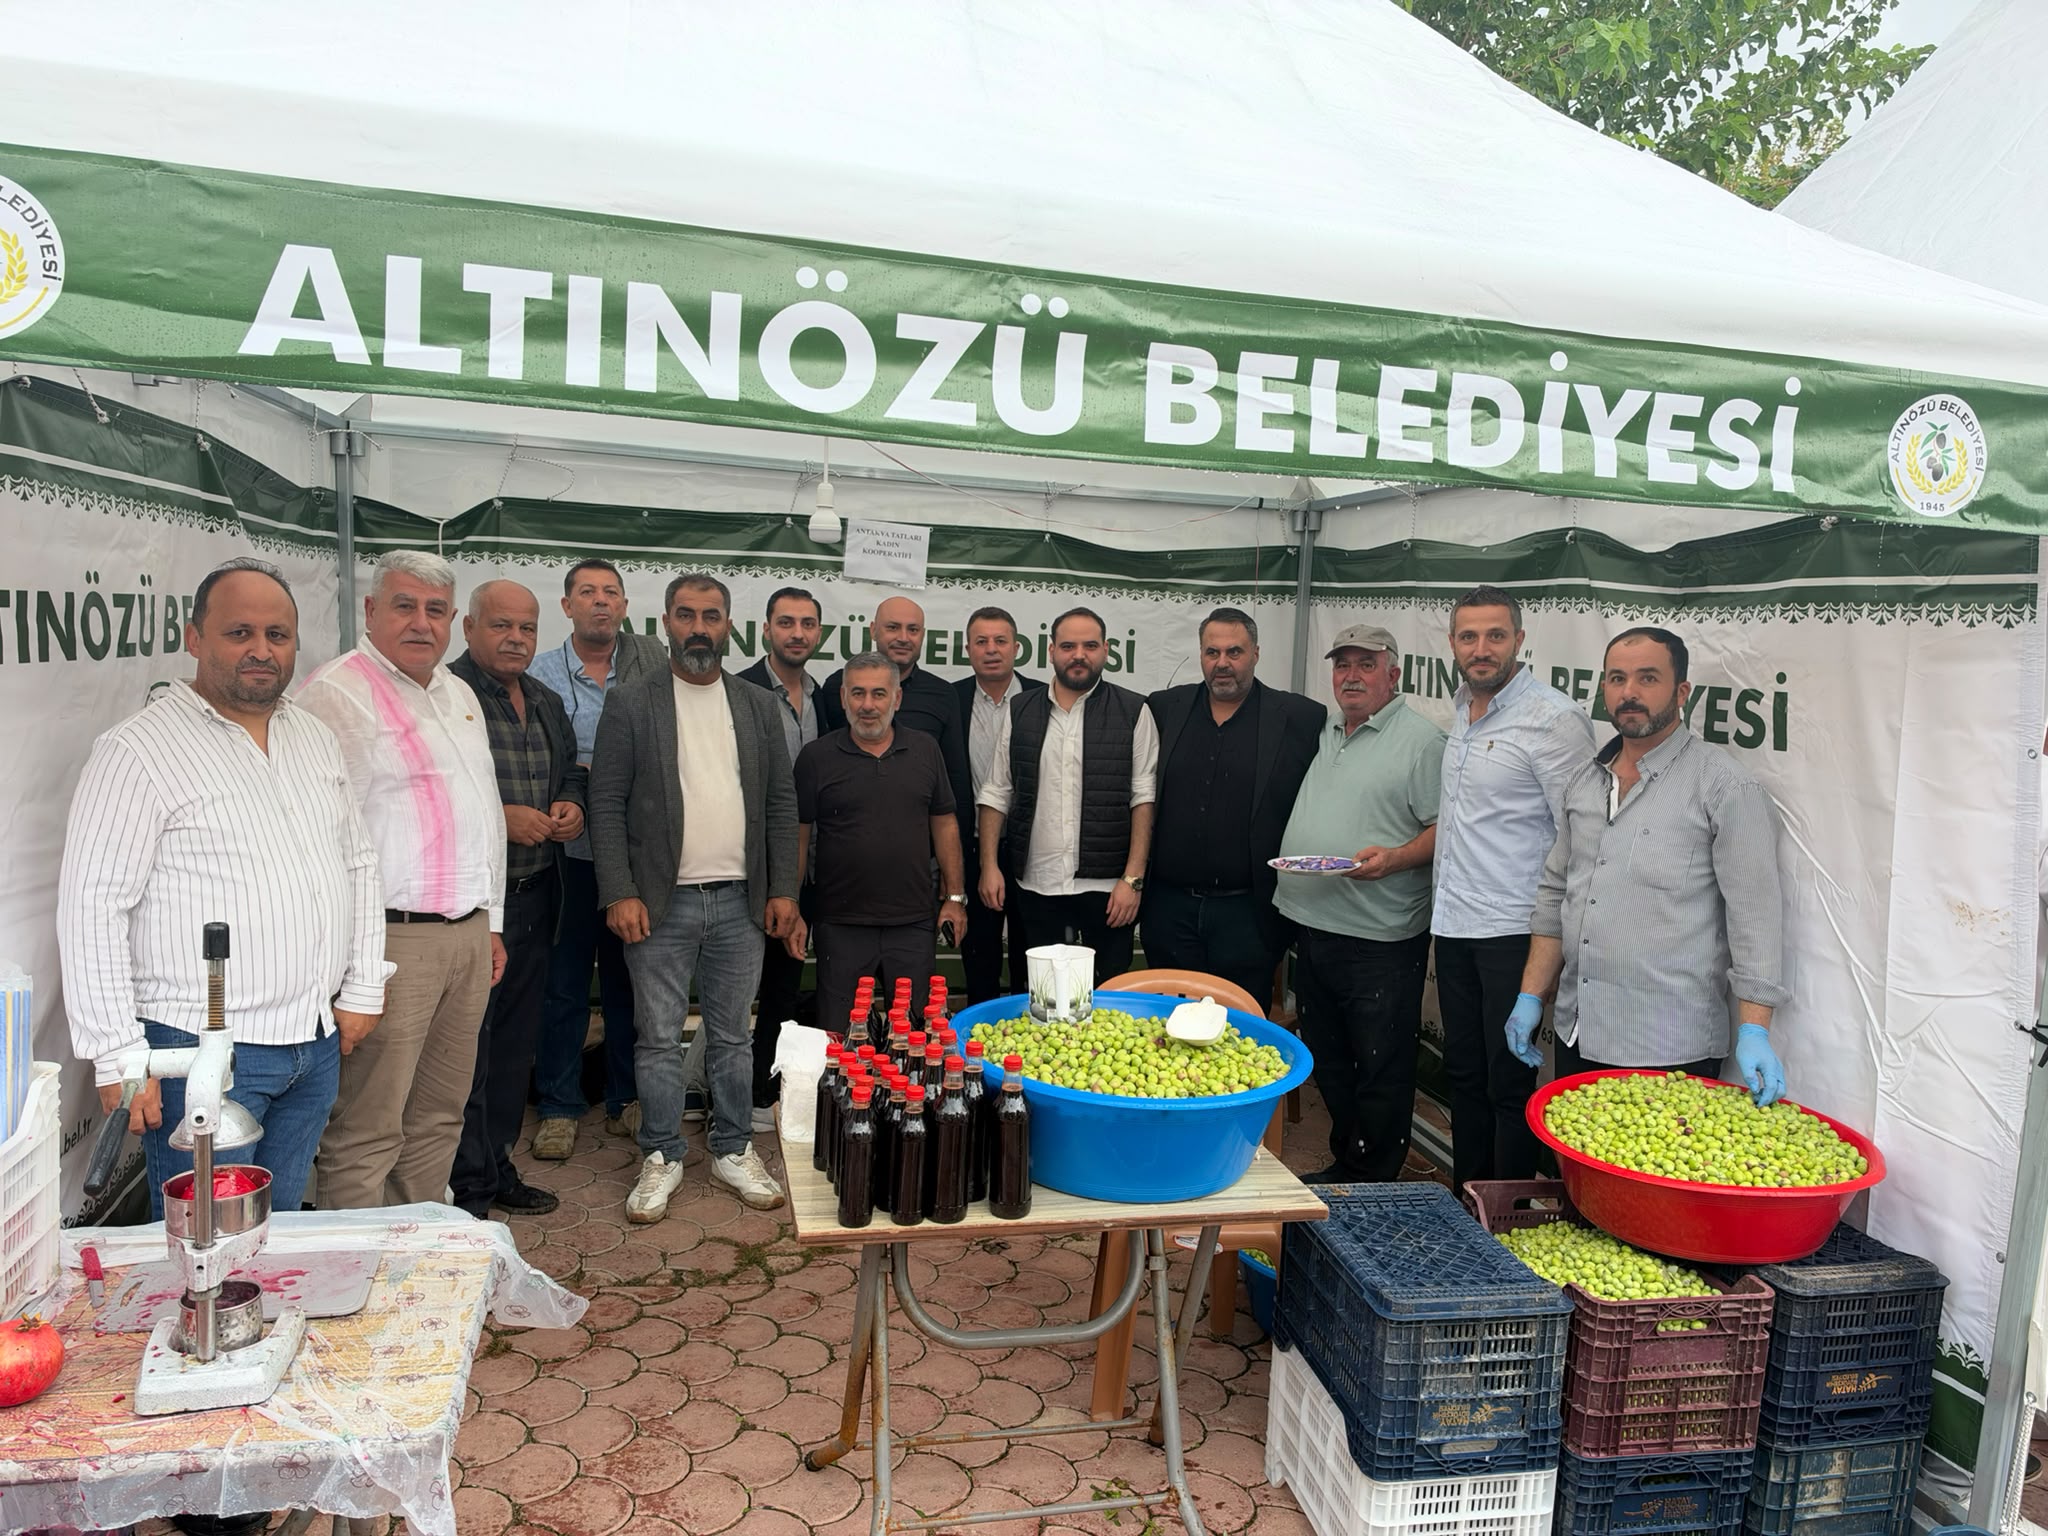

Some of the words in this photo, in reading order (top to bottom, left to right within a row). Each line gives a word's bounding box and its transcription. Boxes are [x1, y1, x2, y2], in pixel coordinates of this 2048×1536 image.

[238, 243, 1087, 437] ALTINÖZÜ
[1144, 341, 1802, 493] BELEDİYESİ
[1891, 399, 1936, 463] ALTINÖZÜ
[1939, 400, 1985, 472] BELEDİYESİ
[1920, 501, 1945, 512] 1945
[856, 528, 890, 538] ANTAKYA
[891, 532, 922, 542] TATLARI
[876, 540, 900, 548] KADIN
[862, 547, 912, 559] KOOPERATİFİ
